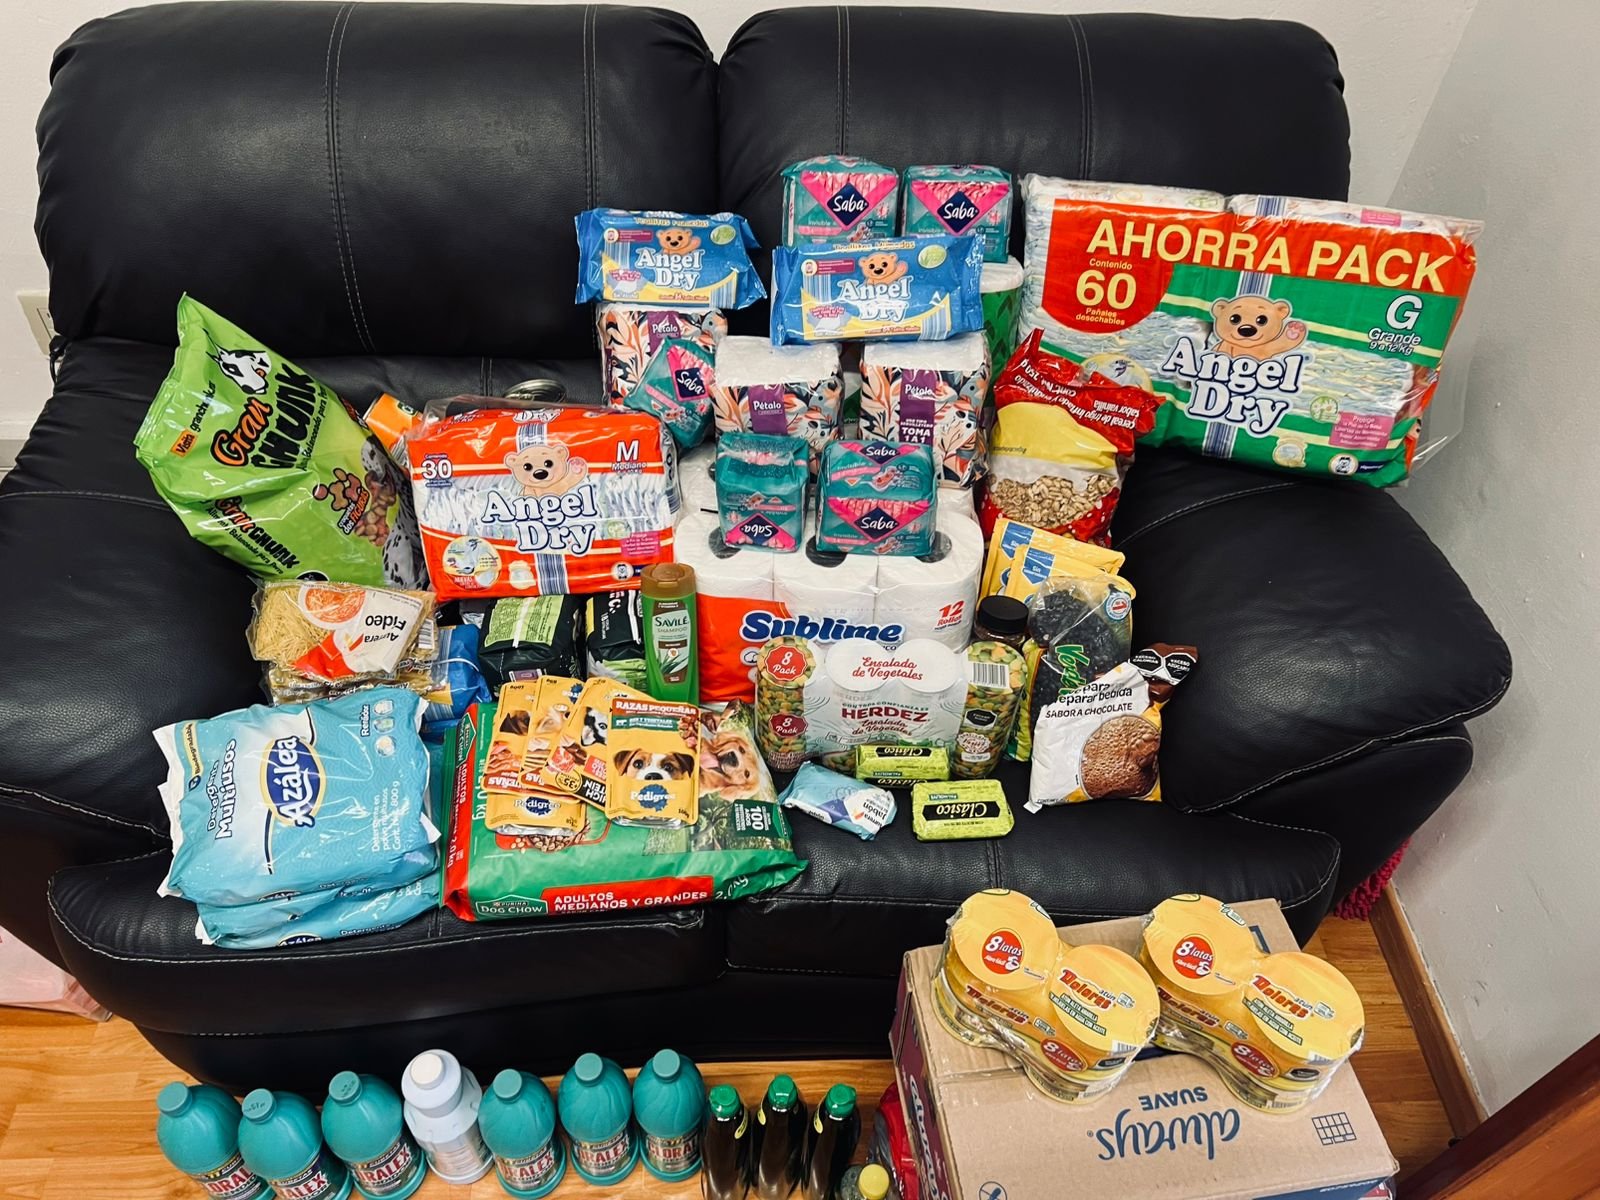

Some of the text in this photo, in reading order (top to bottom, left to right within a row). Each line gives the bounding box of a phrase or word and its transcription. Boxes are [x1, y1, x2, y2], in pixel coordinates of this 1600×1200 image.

[833, 196, 865, 212] Saba
[943, 203, 975, 219] Saba
[636, 248, 704, 271] Angel
[1086, 219, 1456, 293] AHORRA PACK
[1089, 258, 1133, 270] Contenido
[656, 268, 699, 291] Dry
[838, 276, 913, 301] Angel
[1076, 269, 1137, 310] 60
[859, 301, 907, 322] Dry
[1075, 313, 1125, 325] desechables
[1085, 307, 1117, 318] Pañales
[1385, 295, 1421, 330] G
[1368, 327, 1421, 345] Grande
[1369, 341, 1377, 350] 9
[1387, 343, 1398, 353] 12
[1398, 345, 1414, 356] Kg
[1163, 337, 1303, 396] Angel
[678, 371, 704, 394] Saba
[753, 400, 782, 411] Pétalo
[1092, 399, 1140, 419] sabor vainilla
[1189, 378, 1290, 434] Dry
[251, 362, 316, 469] CHUNK
[1112, 416, 1136, 430] cereal
[211, 398, 272, 466] Gran
[901, 427, 931, 437] TOMA
[616, 440, 640, 463] M
[865, 446, 897, 457] Saba
[421, 459, 453, 480] 30
[611, 461, 647, 471] Mediano
[482, 485, 596, 524] Angel
[213, 496, 255, 534] Gran
[861, 516, 895, 530] Saba
[516, 521, 595, 554] Dry
[741, 521, 773, 537] Saba
[250, 525, 300, 570] CHUNK
[939, 601, 965, 619] 12
[365, 614, 407, 630] Fideo
[655, 616, 689, 627] SAVILÉ
[742, 612, 904, 643] Sublime
[781, 651, 792, 665] 8
[862, 656, 917, 669] Ensalada
[773, 664, 797, 676] Pack
[852, 667, 923, 681] de Vegetales
[1098, 687, 1132, 701] bebida
[616, 701, 648, 711] RAZAS
[841, 706, 929, 723] HERDEZ
[1045, 708, 1075, 719] SABOR
[1084, 702, 1133, 716] CHOCOLATE
[775, 725, 798, 735] Pack
[782, 717, 792, 727] 8
[852, 725, 913, 737] de Vegetales
[861, 719, 908, 728] Ensalada
[884, 746, 923, 757] Clásico
[215, 738, 237, 840] Multiusos
[273, 735, 315, 828] Azálea
[459, 763, 467, 804] ADULTOS
[391, 788, 399, 807] 800
[472, 803, 486, 820] kg
[752, 806, 764, 830] 100
[862, 802, 888, 823] Jabón
[936, 802, 987, 820] Clásico
[554, 892, 614, 905] ADULTOS
[555, 899, 628, 912] MEDIANOS
[632, 898, 640, 906] Y
[644, 891, 708, 906] GRANDES
[481, 905, 543, 914] DOG CHOW
[985, 936, 1023, 957] 8 latas
[1176, 941, 1214, 962] 8 latas
[1060, 969, 1112, 1010] Dolores
[1253, 974, 1309, 1019] Dolores
[1042, 1041, 1059, 1053] 8
[1233, 1045, 1250, 1057] 8
[1138, 1086, 1208, 1111] SUAVE
[1096, 1108, 1241, 1161] always
